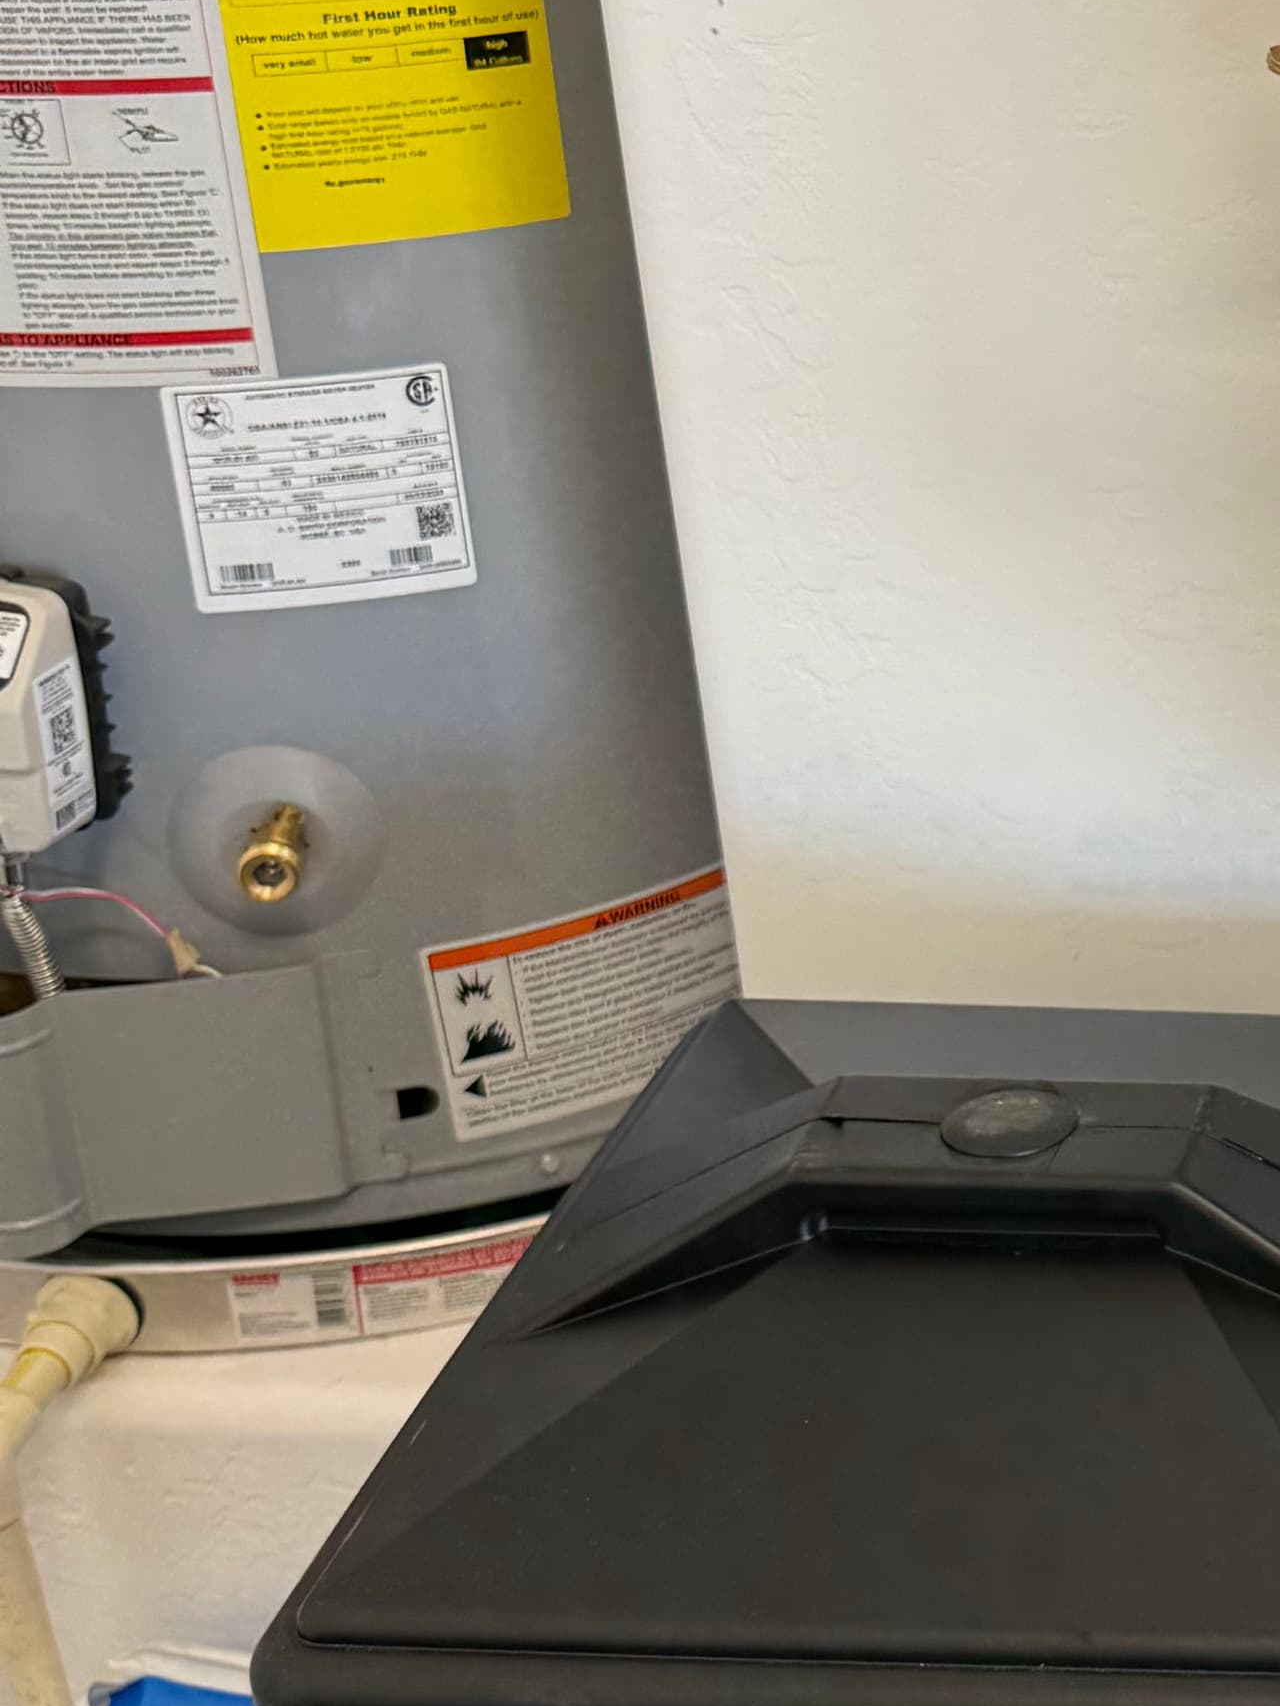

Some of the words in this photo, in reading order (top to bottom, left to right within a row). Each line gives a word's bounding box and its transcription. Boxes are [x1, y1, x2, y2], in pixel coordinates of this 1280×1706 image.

[322, 11, 360, 25] First
[364, 8, 401, 22] Hour
[407, 4, 457, 18] Rating
[235, 34, 267, 45] (How
[271, 32, 305, 43] much
[308, 29, 329, 40] hot
[331, 28, 364, 38] water
[367, 26, 390, 38] you
[393, 24, 411, 36] get
[414, 22, 425, 32] in
[428, 20, 446, 30] the
[449, 17, 471, 28] first
[474, 15, 499, 25] hour
[502, 12, 513, 22] of
[515, 9, 540, 21] use)
[485, 38, 508, 51] high
[264, 60, 285, 70] very
[352, 53, 372, 64] low
[609, 890, 682, 925] WARNING
